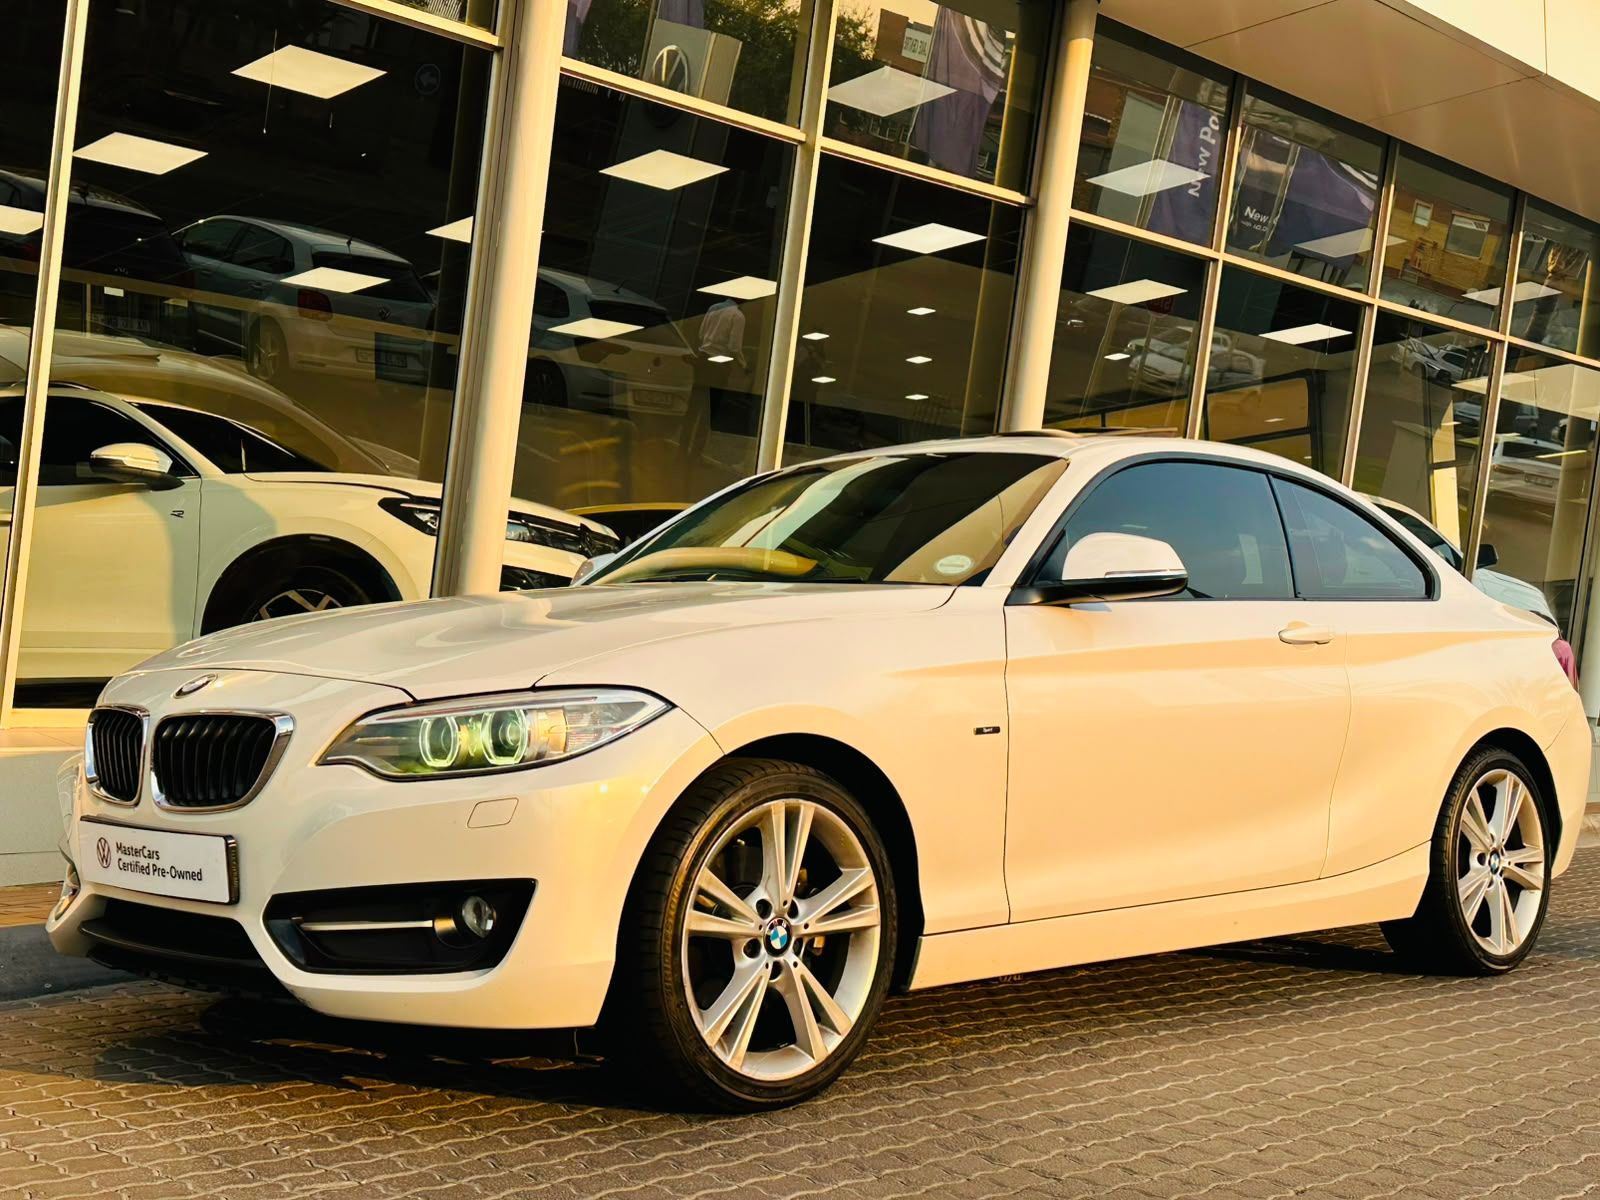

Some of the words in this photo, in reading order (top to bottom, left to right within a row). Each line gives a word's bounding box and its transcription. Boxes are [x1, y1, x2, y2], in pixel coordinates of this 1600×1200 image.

[1244, 206, 1269, 223] New
[115, 842, 160, 861] MasterCars
[117, 858, 151, 876] Certified
[152, 863, 203, 882] Pre-Owned
